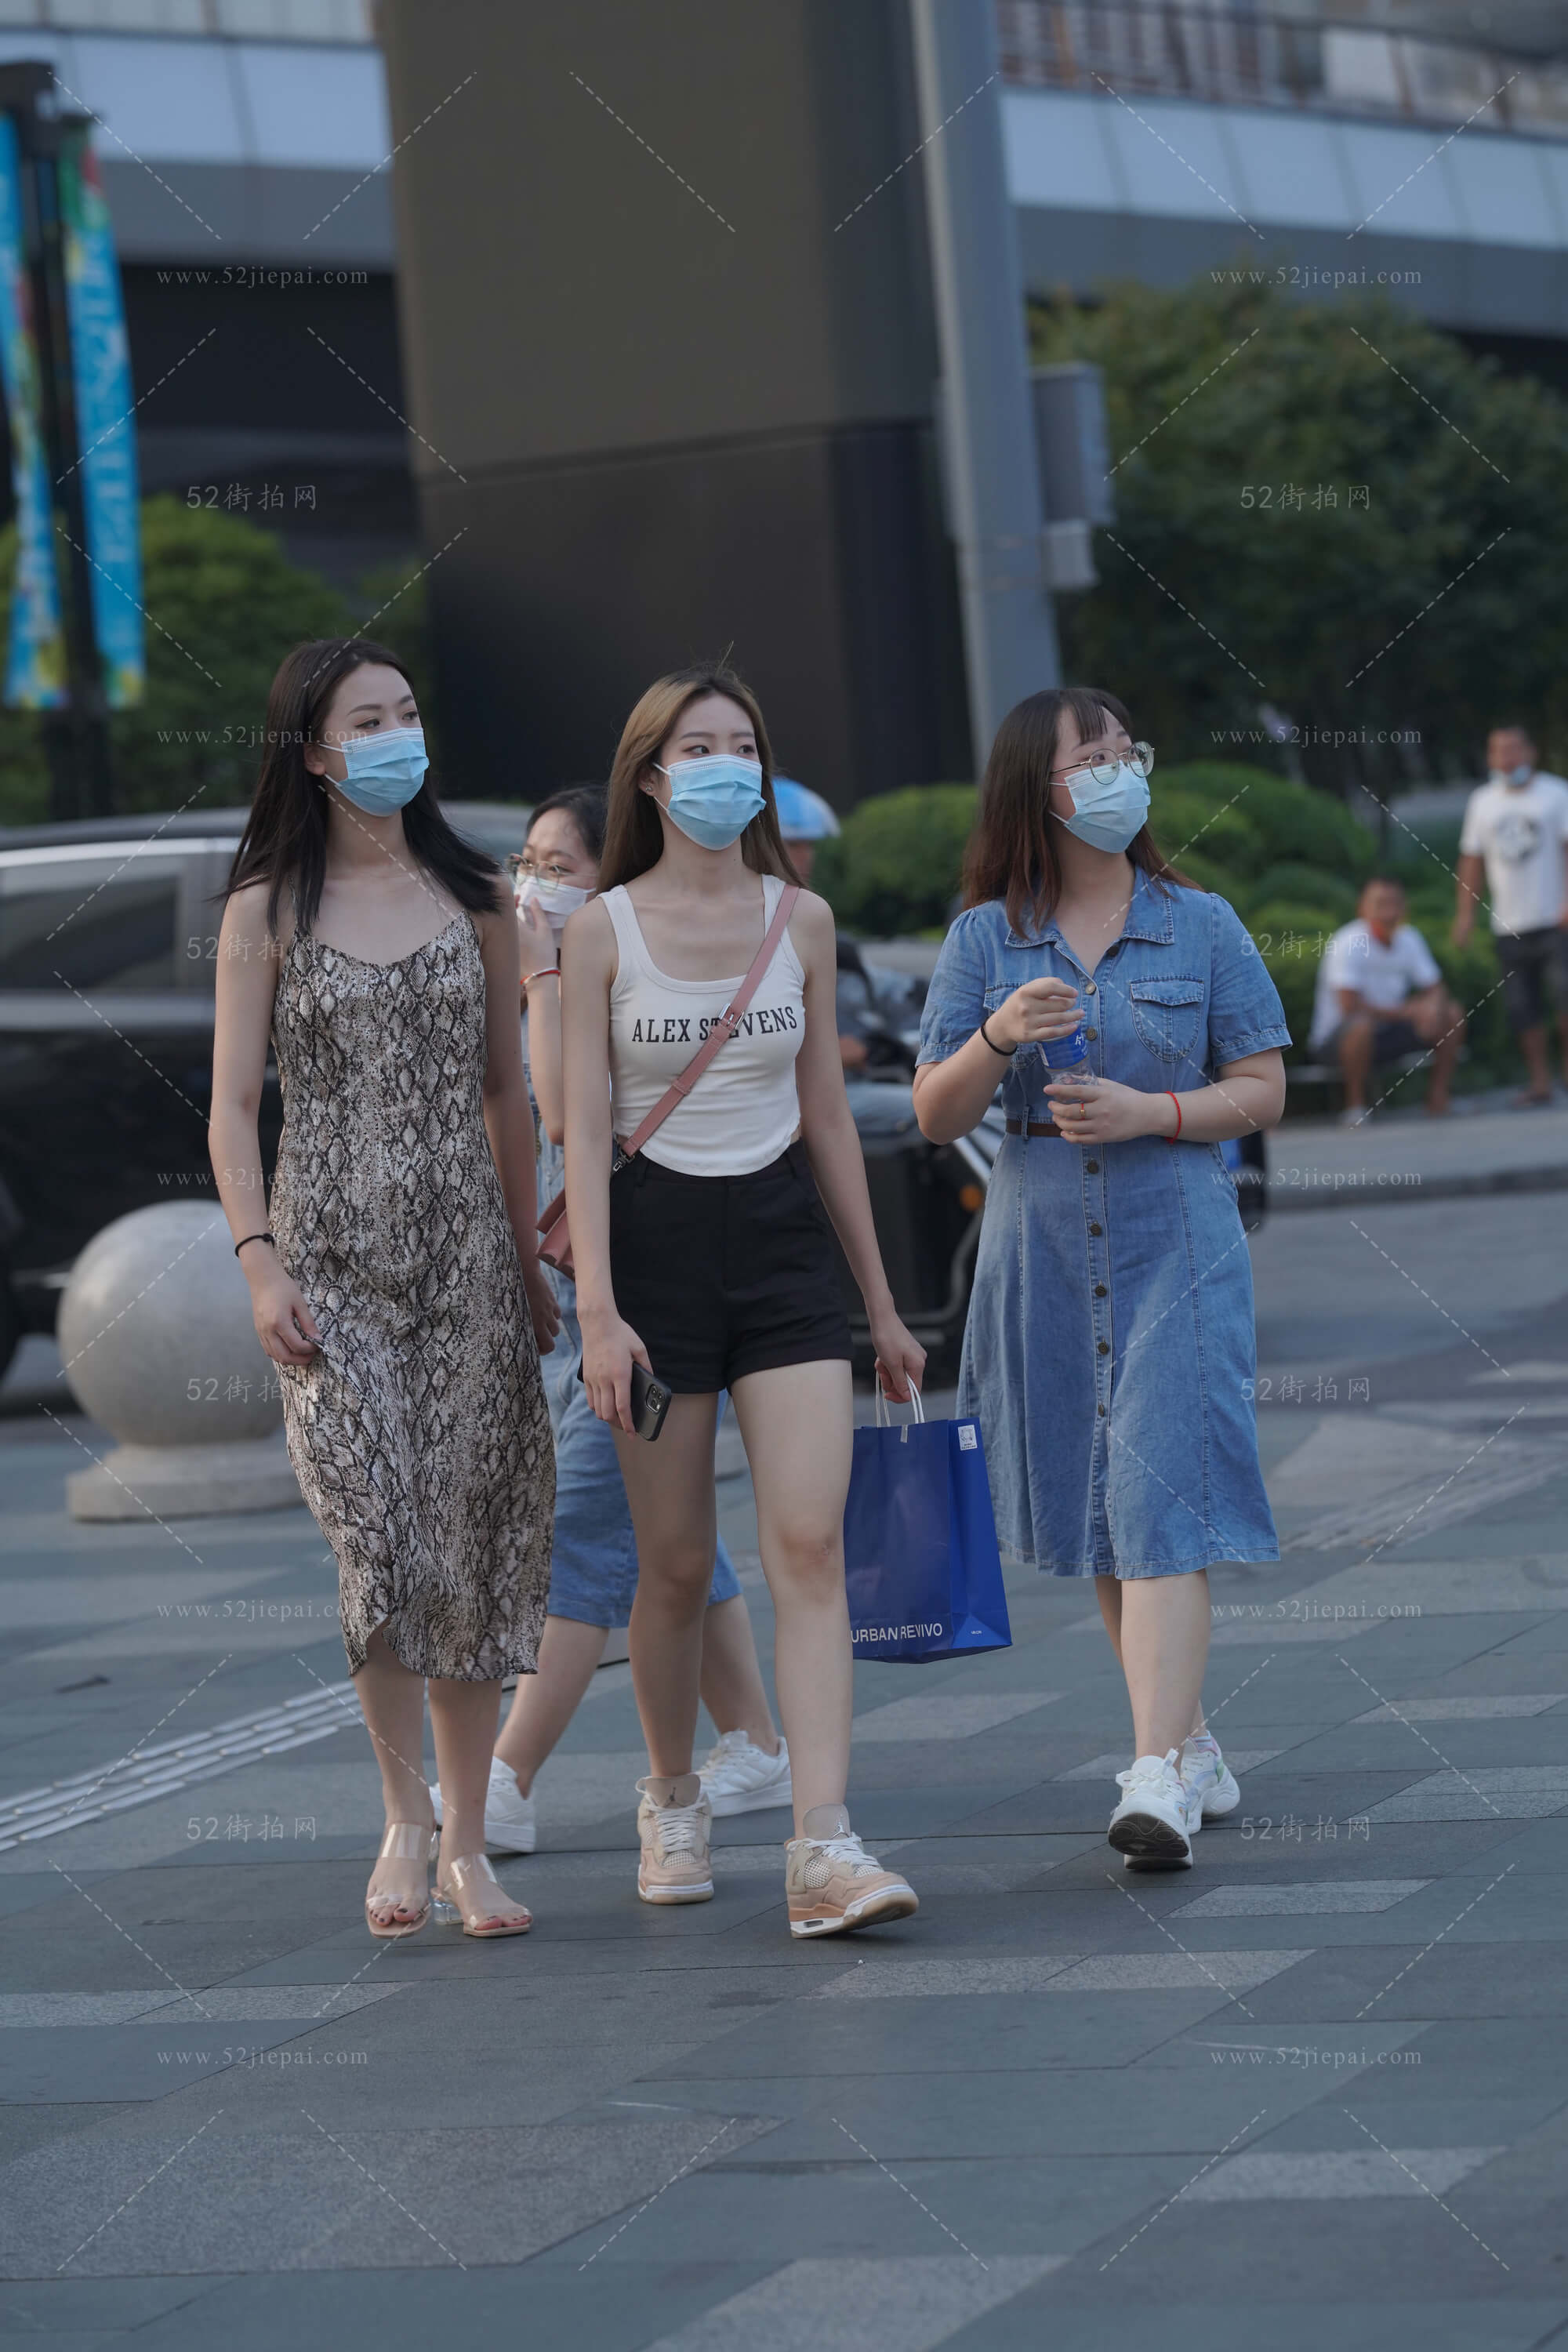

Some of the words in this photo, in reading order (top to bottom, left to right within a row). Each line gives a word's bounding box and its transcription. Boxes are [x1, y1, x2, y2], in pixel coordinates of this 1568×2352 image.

[632, 1018, 691, 1043] ALEX
[851, 1627, 898, 1642] URBAN
[900, 1623, 943, 1639] REVIVO
